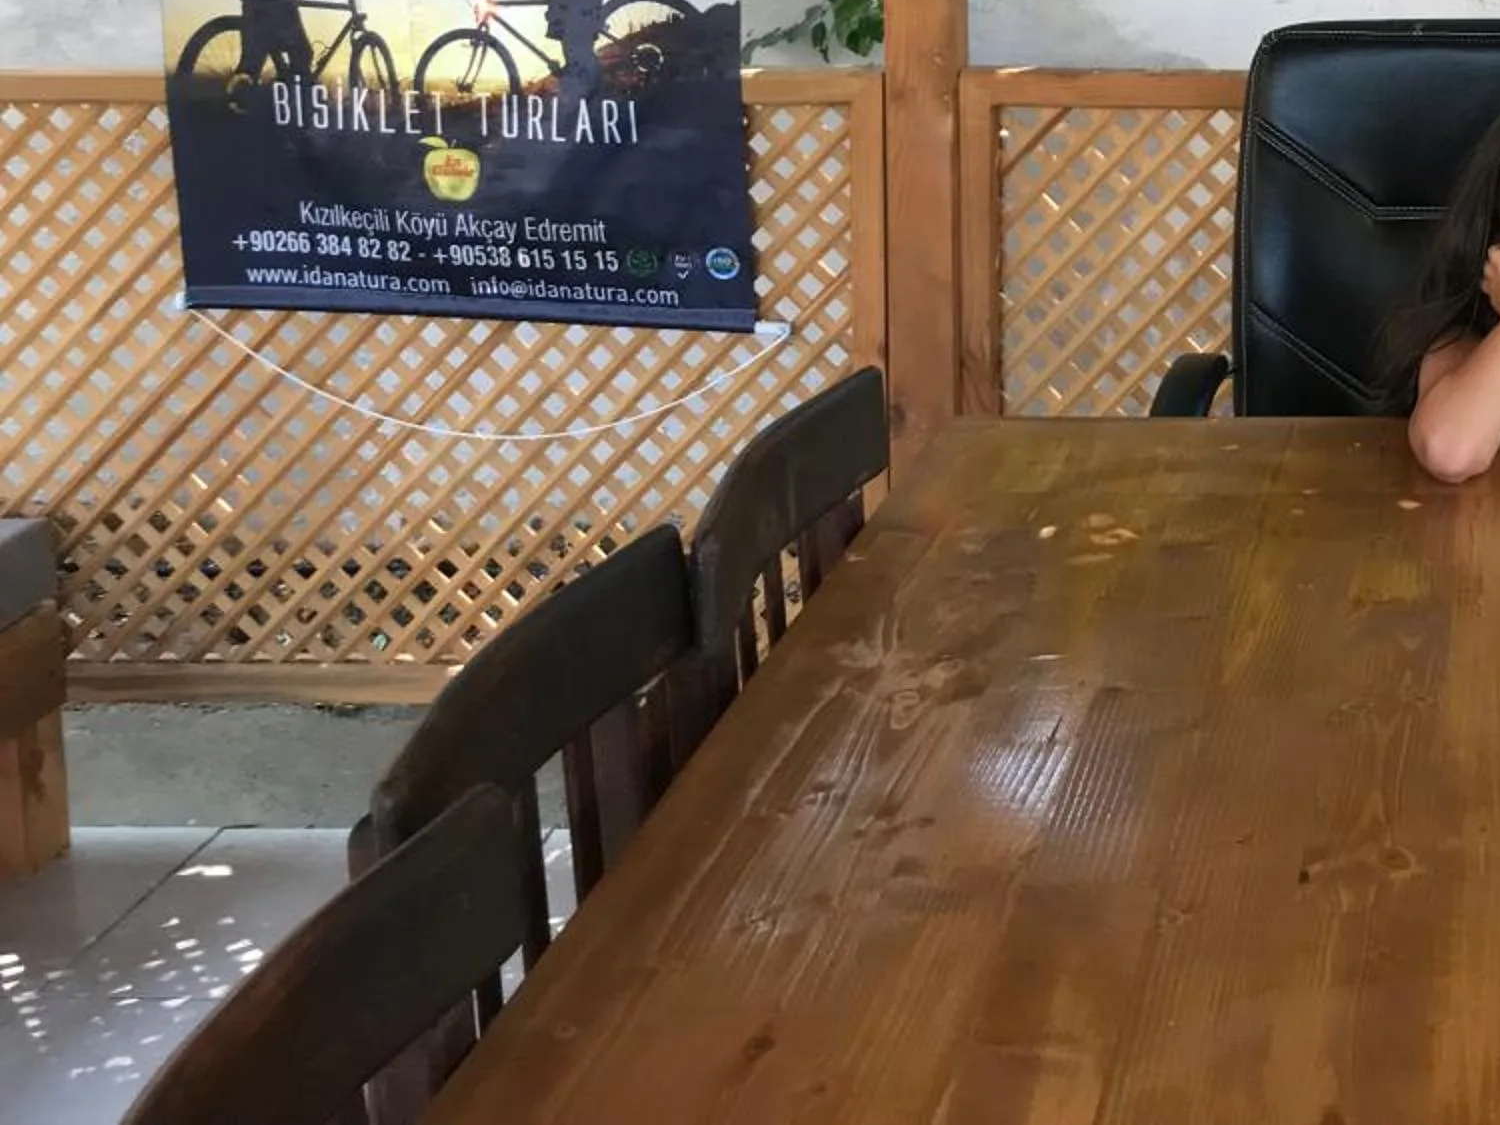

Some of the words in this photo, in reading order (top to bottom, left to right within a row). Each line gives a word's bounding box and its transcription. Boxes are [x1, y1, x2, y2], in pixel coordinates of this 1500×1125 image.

[479, 91, 639, 144] TURLARI
[395, 210, 448, 240] Köyü
[454, 213, 517, 245] Akçay
[523, 217, 608, 244] Edremit
[232, 230, 311, 254] +90266
[316, 233, 352, 256] 384
[358, 237, 383, 259] 82
[387, 239, 412, 262] 82
[433, 244, 511, 269] +90538
[517, 247, 555, 270] 615
[562, 250, 587, 270] 15
[594, 250, 619, 272] 15
[246, 264, 450, 294] www.idanatura.com
[471, 276, 679, 306] info@idanatura.com
